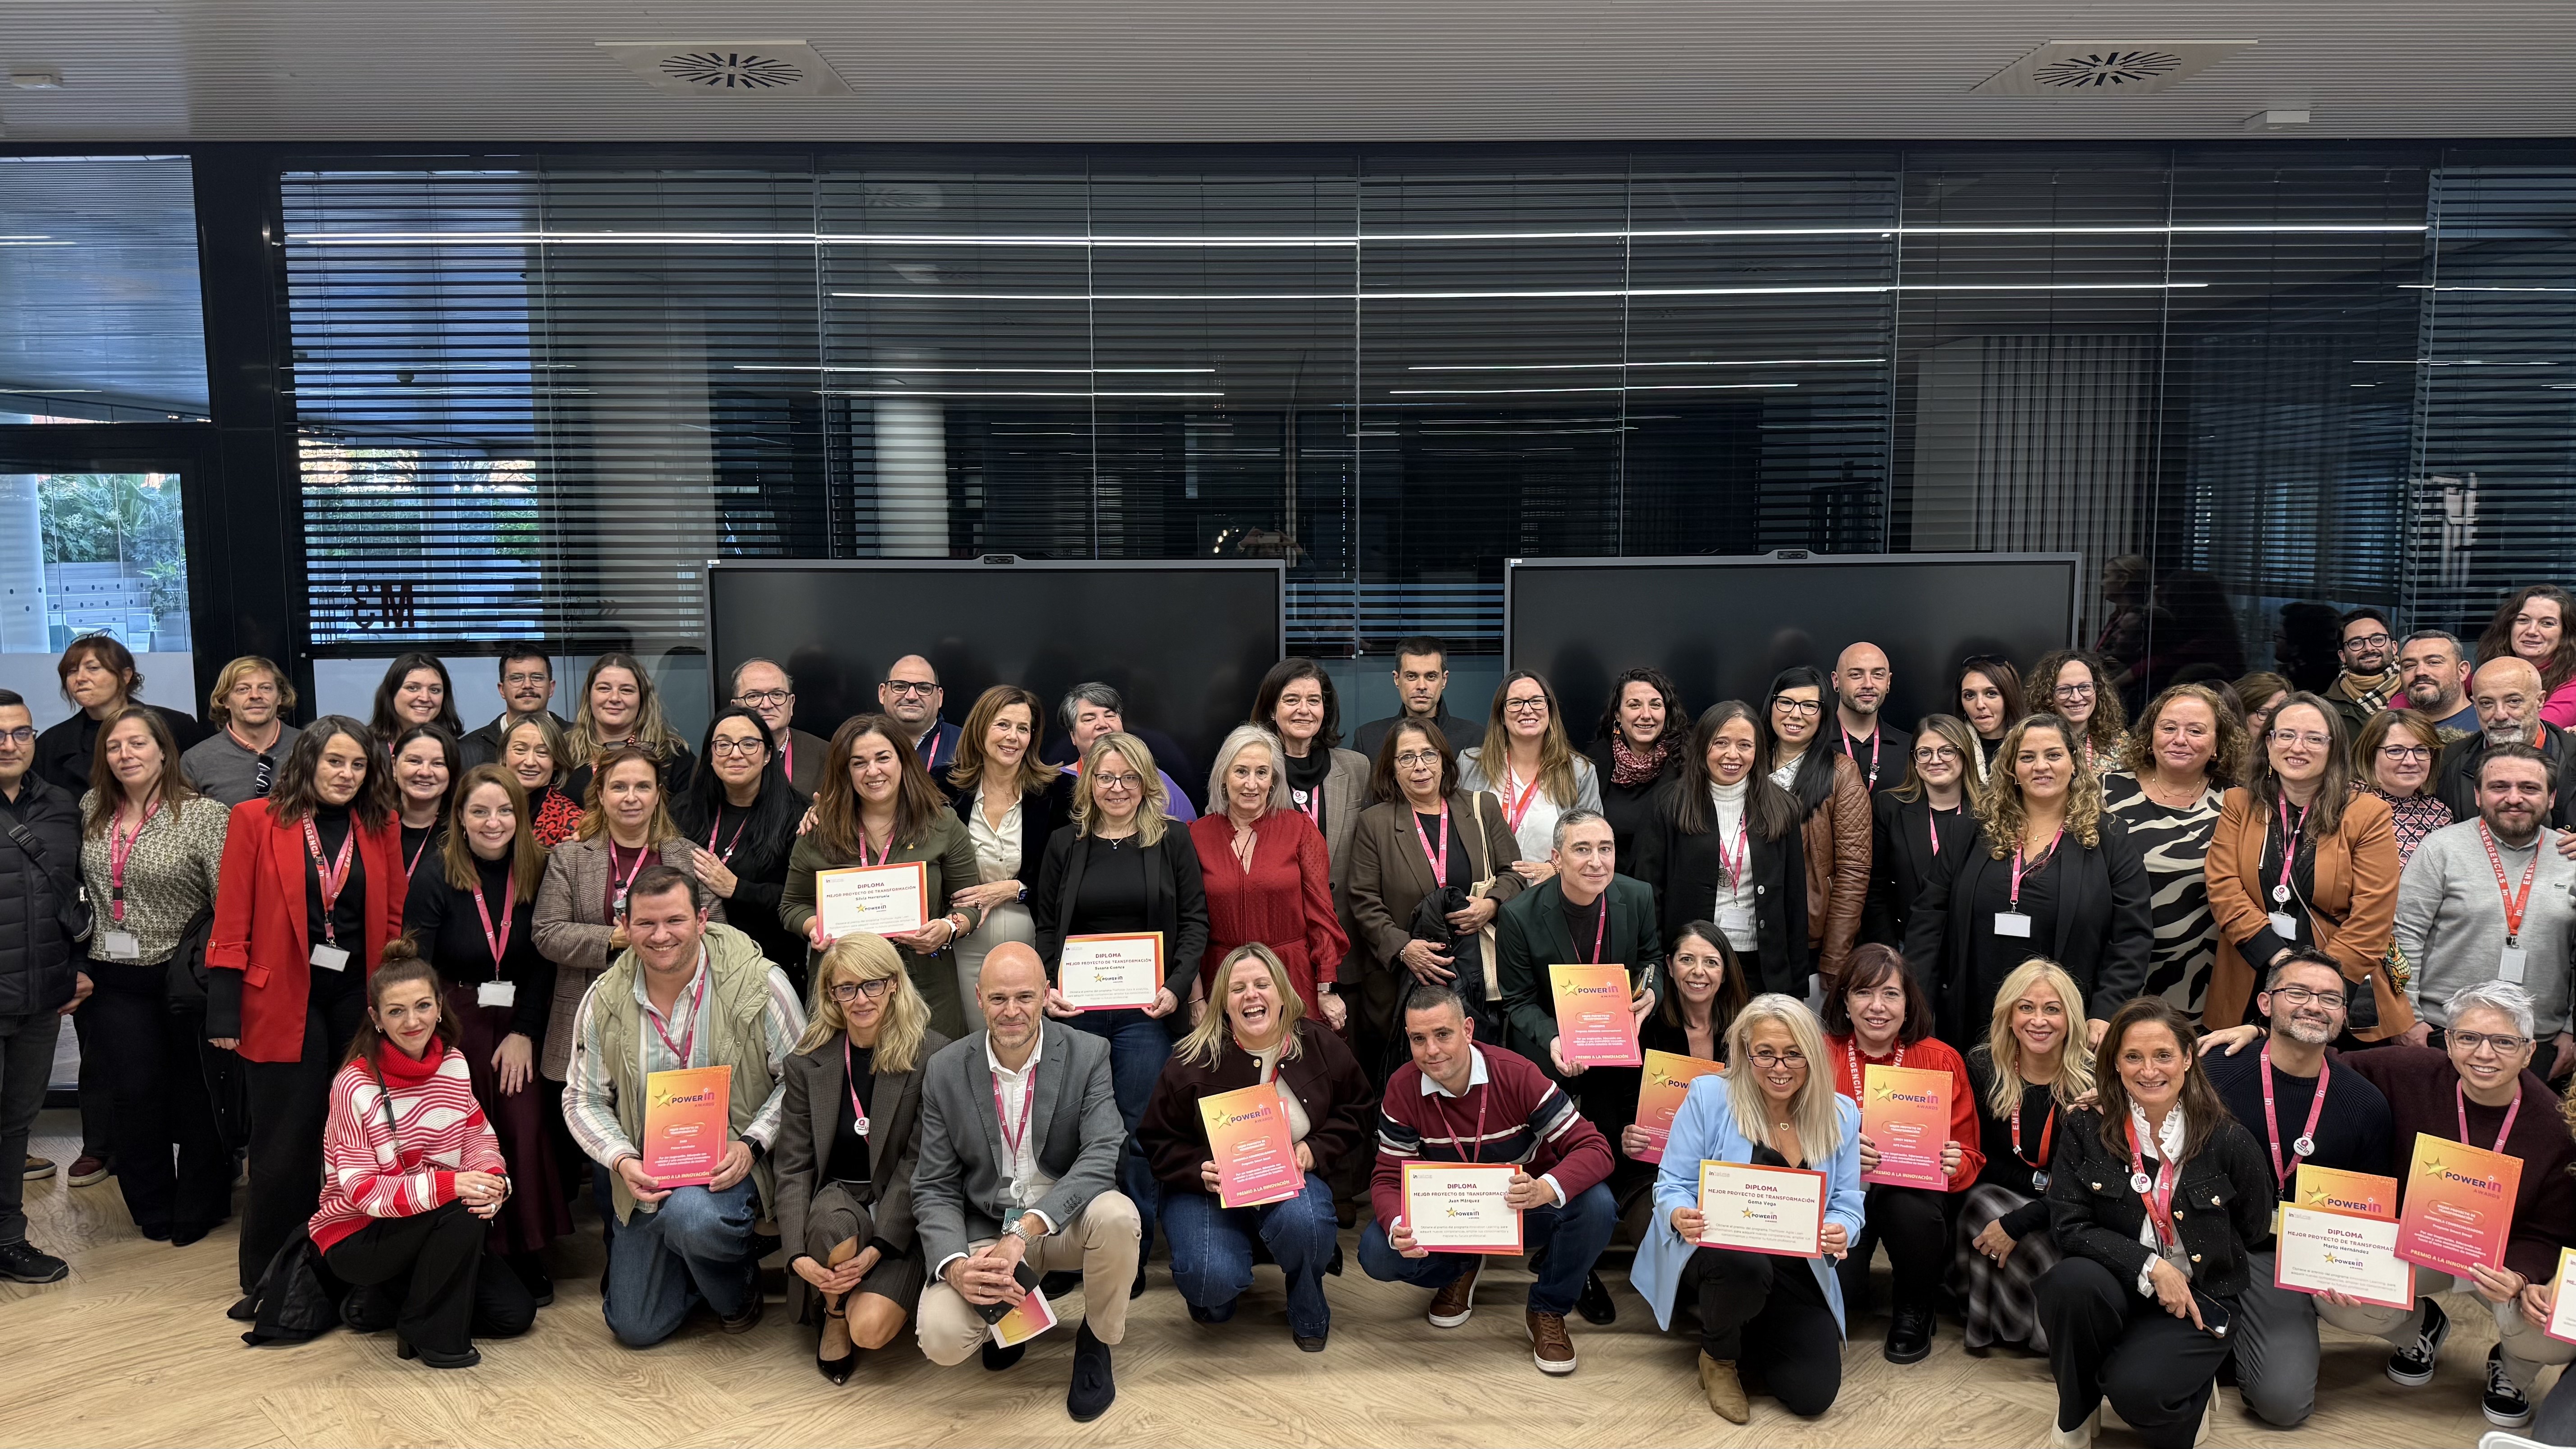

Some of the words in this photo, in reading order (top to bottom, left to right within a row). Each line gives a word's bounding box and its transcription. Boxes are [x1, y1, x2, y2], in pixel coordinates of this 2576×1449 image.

[302, 808, 321, 858] EMERGENCI
[2479, 824, 2506, 884] EMERGENCIAS
[875, 886, 916, 894] TRANSFORMACIÓN
[1848, 1039, 1863, 1101] EMERGENCIAS
[1745, 1184, 1777, 1192] DIPLOMA
[1766, 1194, 1815, 1203] TRANSFORMACIÓN
[2474, 1189, 2500, 1199] AWARDS
[2328, 1228, 2363, 1239] DIPLOMA
[2308, 1234, 2338, 1242] PROYECTO
[2350, 1241, 2393, 1251] TRANSFORMAC
[2340, 1247, 2369, 1255] Hernández
[2410, 1249, 2432, 1259] PREMIO
[2446, 1260, 2471, 1270] INNOVA
